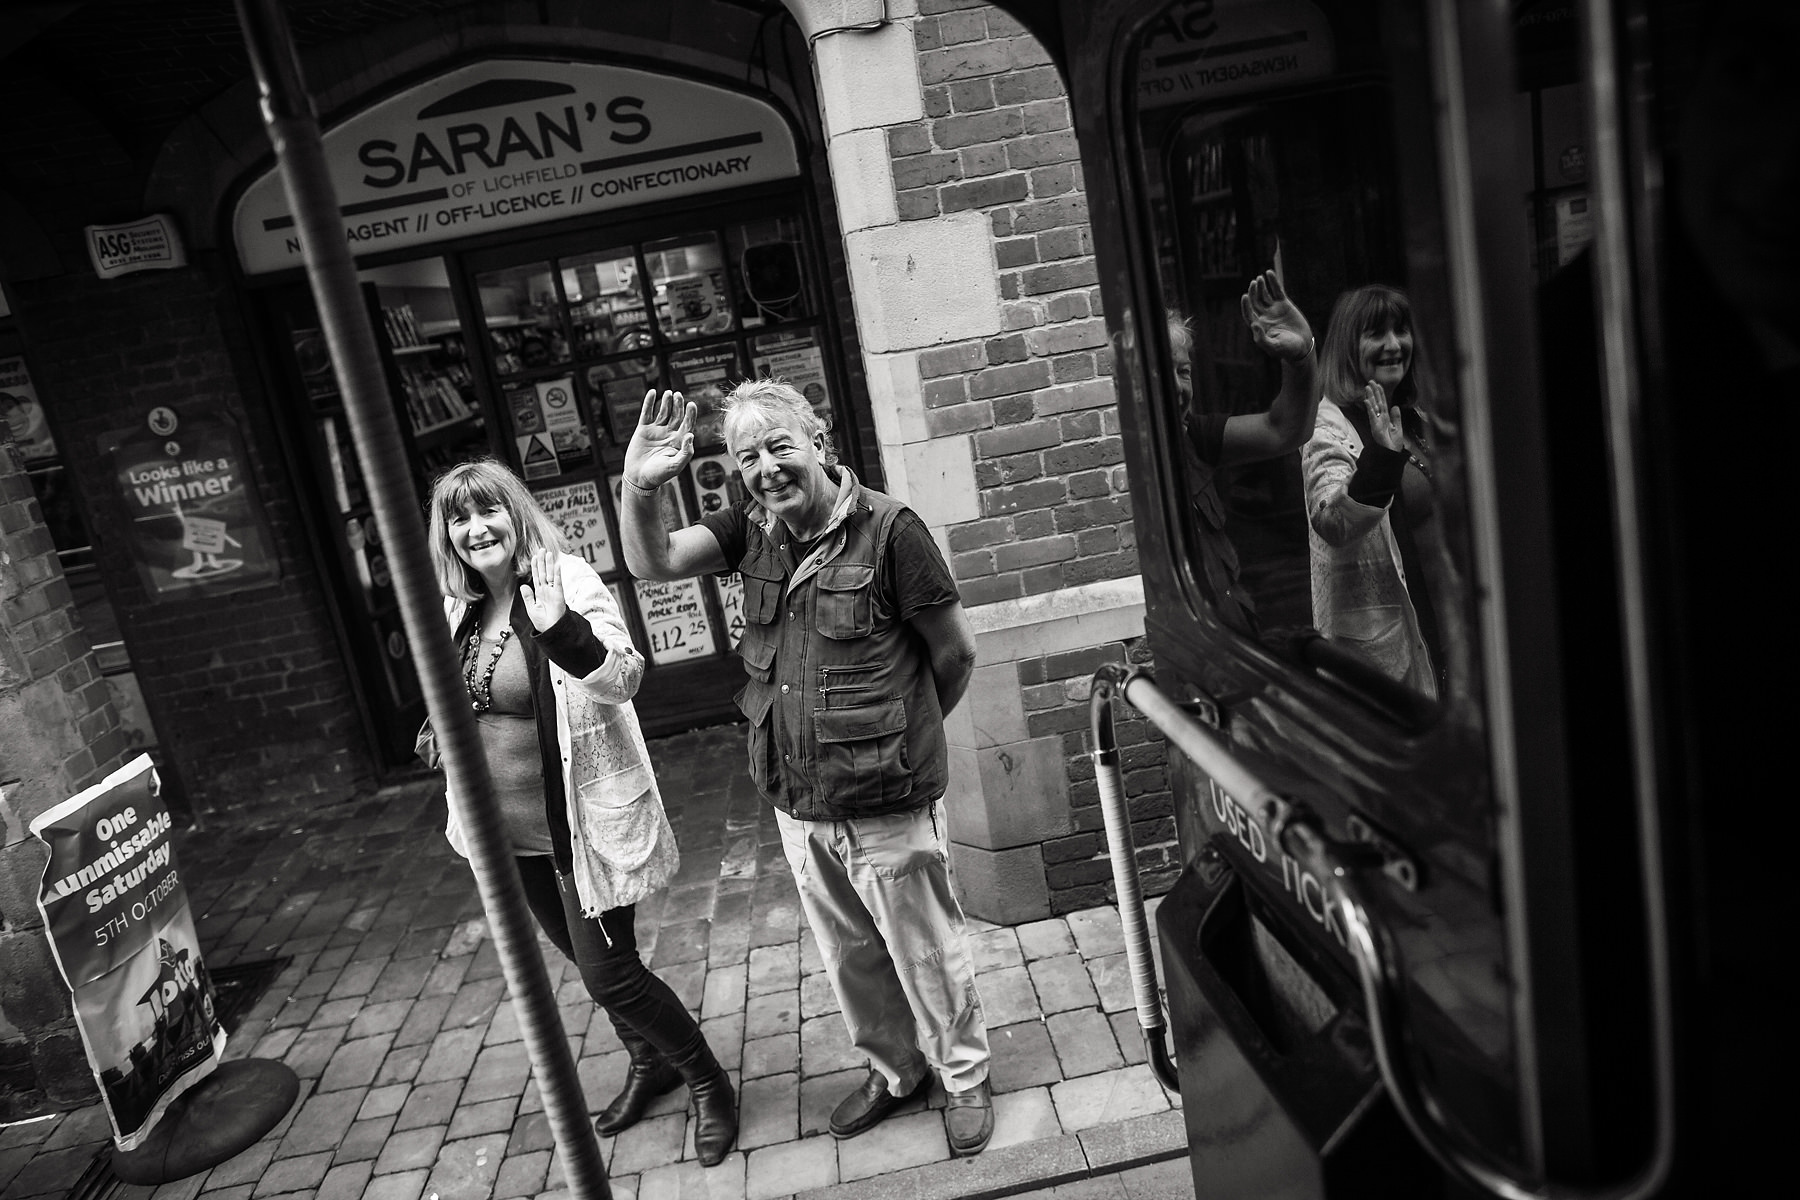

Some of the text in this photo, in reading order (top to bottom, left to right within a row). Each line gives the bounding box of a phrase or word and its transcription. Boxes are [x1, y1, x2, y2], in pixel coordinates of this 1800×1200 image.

[358, 96, 652, 188] SARAN'S
[451, 163, 578, 198] OF LICHFIELD
[286, 217, 409, 254] NAGENT
[436, 189, 565, 226] OFF-LICENCE
[590, 155, 752, 198] CONFECTIONARY
[98, 233, 130, 259] ASG
[669, 357, 705, 370] Thanks
[129, 458, 229, 485] Looks like a
[133, 475, 233, 507] Winner
[567, 492, 595, 509] FALLS
[569, 484, 594, 496] OFFER
[639, 585, 669, 599] PRINCE
[648, 606, 673, 620] DARK
[95, 806, 138, 842] One
[53, 811, 172, 897] unmissable
[1209, 778, 1348, 948] USED TICK
[85, 841, 170, 914] Saturday
[94, 870, 179, 947] 5TH OCTOBER
